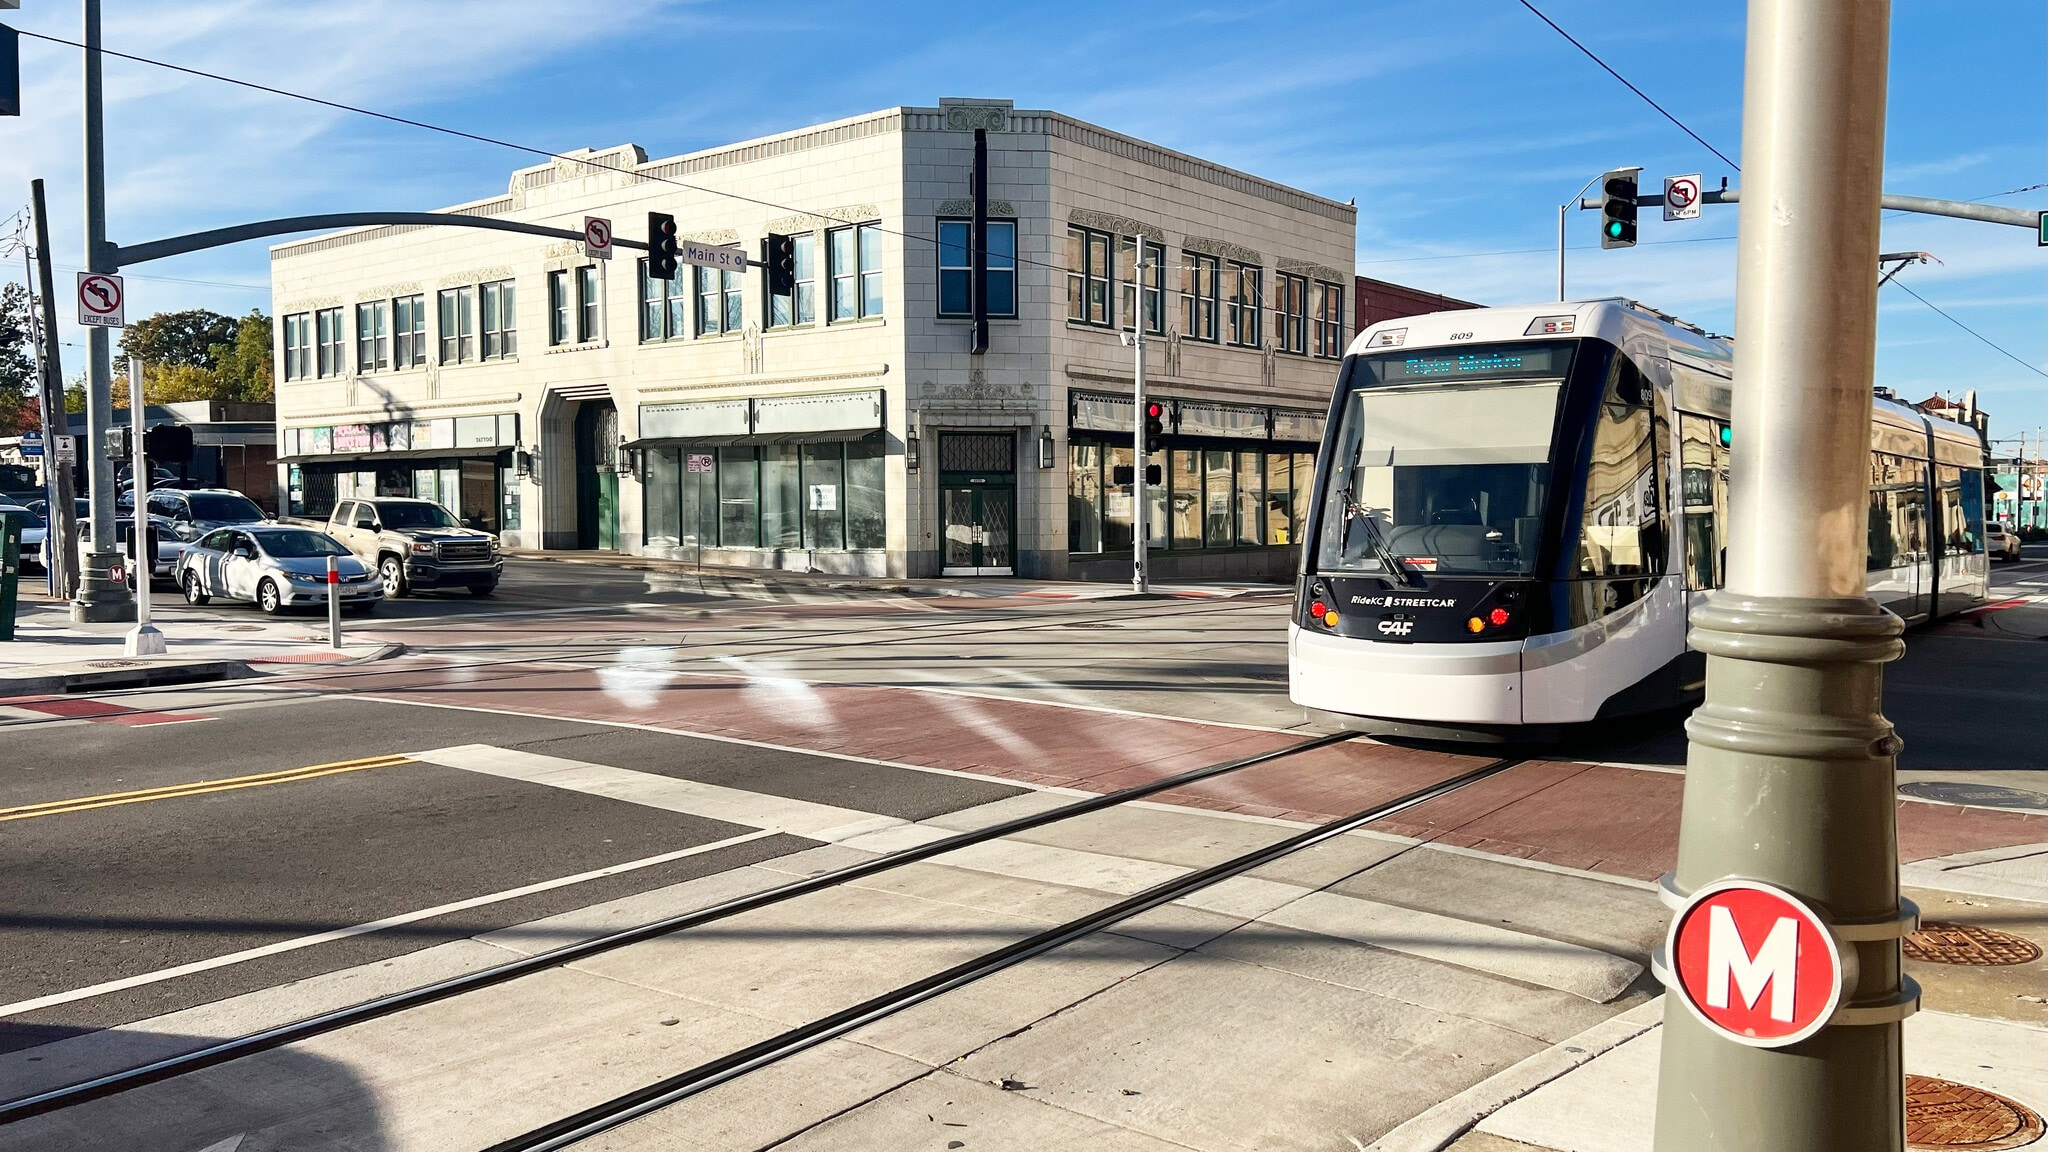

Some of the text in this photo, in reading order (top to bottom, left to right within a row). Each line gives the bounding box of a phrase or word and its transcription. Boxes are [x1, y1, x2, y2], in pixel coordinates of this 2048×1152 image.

[688, 247, 730, 265] Main St
[84, 314, 120, 326] EXCEPT BUSES
[1449, 332, 1473, 341] 809
[1640, 388, 1652, 401] 809
[112, 568, 122, 580] M
[1350, 596, 1455, 608] RideKC STREETCAR
[1377, 620, 1414, 636] CAF
[1706, 905, 1799, 1023] M
